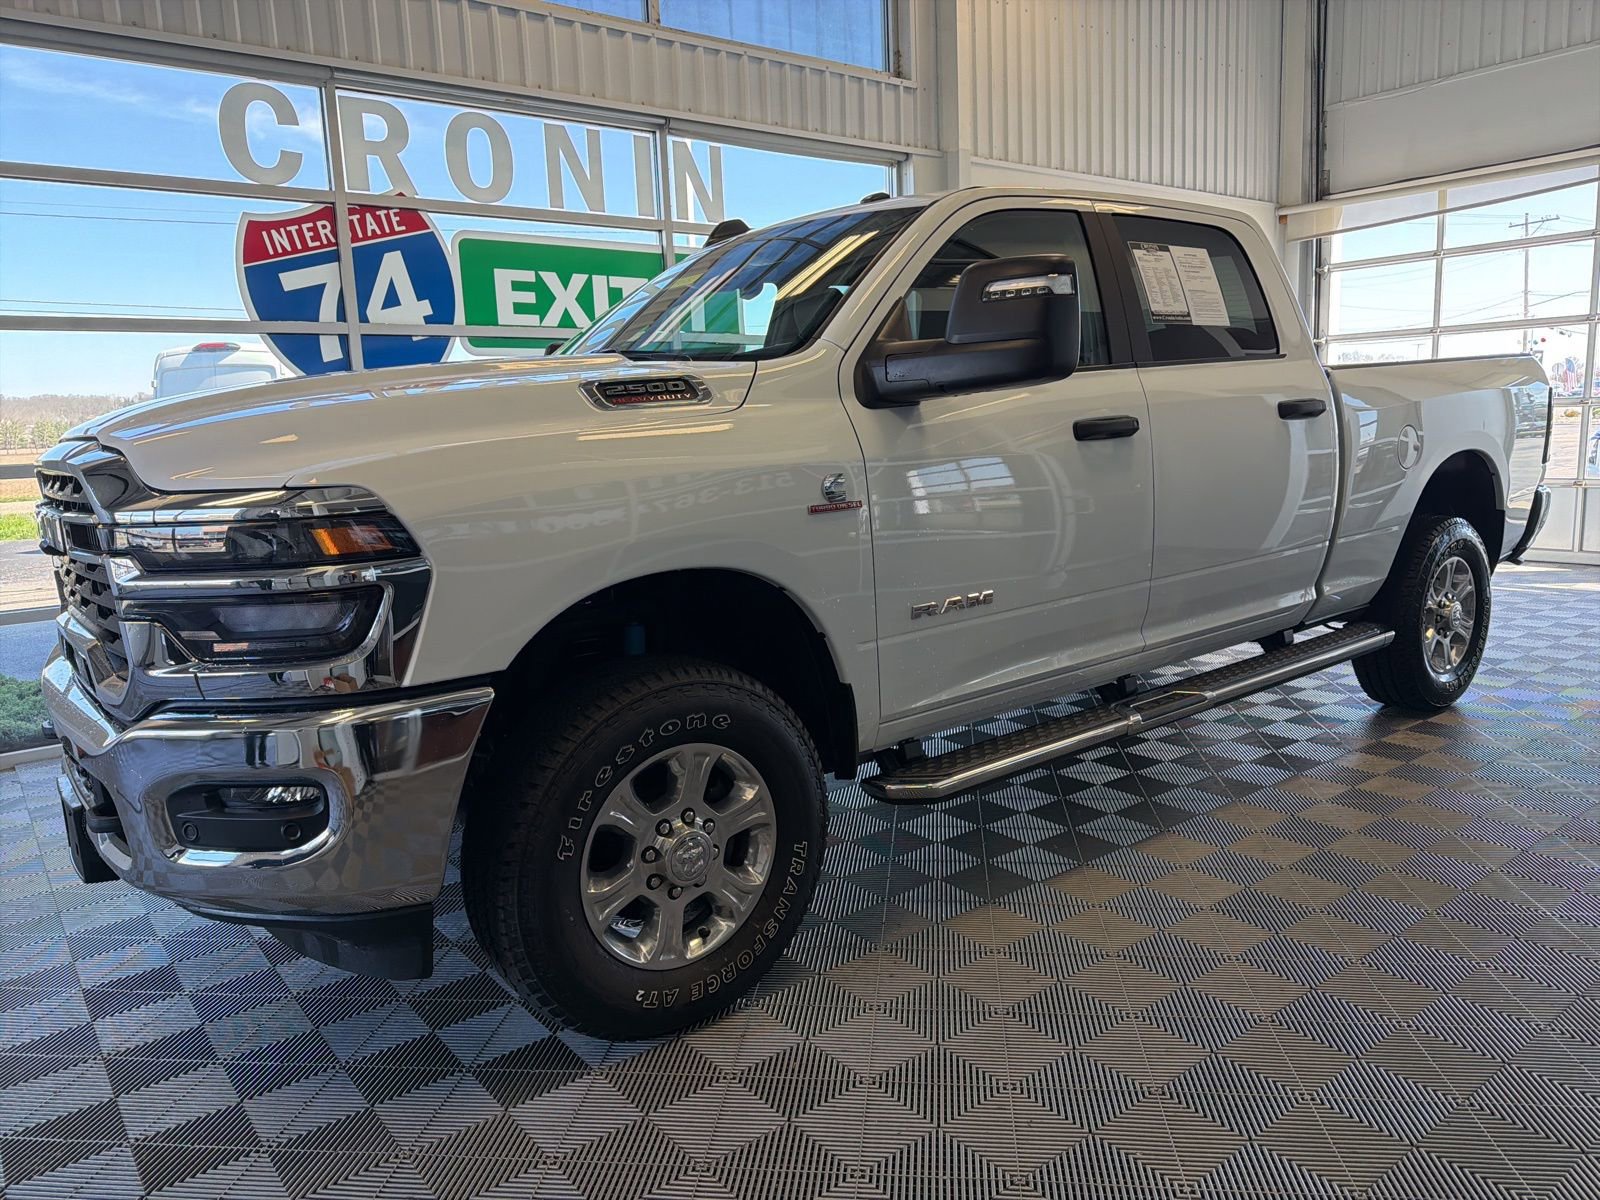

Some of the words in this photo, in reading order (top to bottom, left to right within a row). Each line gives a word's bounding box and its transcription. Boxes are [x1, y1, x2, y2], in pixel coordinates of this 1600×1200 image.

[218, 82, 724, 223] CRONIN
[262, 209, 406, 256] INTERTATE
[278, 250, 433, 363] 74
[606, 381, 686, 395] 2500
[612, 395, 655, 405] HEAVY
[657, 392, 692, 401] DUTY
[811, 504, 836, 512] TURBO
[837, 501, 862, 509] DIESEL
[911, 590, 994, 620] RAM
[556, 712, 732, 861] Firestone
[691, 841, 808, 1001] TRANSFORCE
